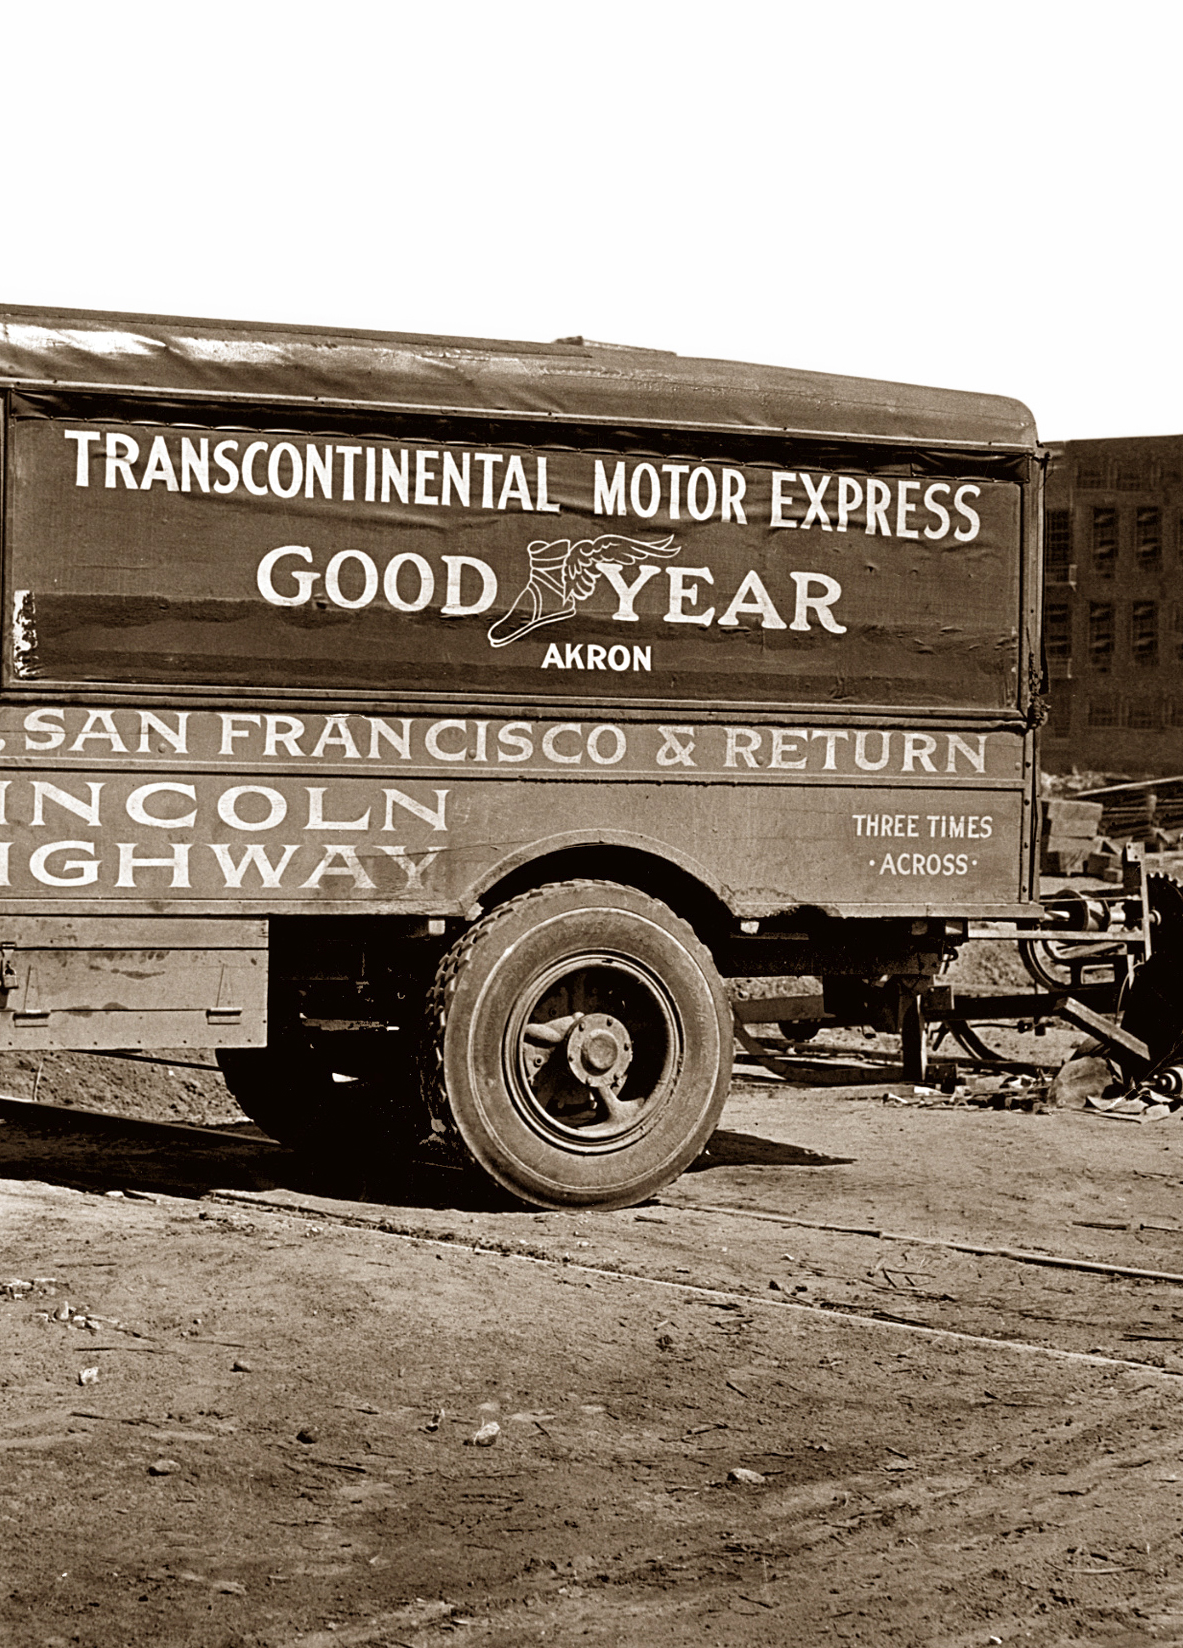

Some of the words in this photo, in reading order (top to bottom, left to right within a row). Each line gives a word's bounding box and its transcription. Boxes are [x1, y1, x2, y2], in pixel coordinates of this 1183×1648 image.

[64, 429, 561, 512] TRANSCONTINENTAL
[593, 460, 747, 525] MOTOR
[770, 471, 981, 542] EXPRESS
[257, 545, 499, 615] GOOD
[595, 563, 848, 634] YEAR
[541, 643, 652, 671] AKRON
[24, 709, 191, 754] SAN
[217, 713, 626, 765] FRANCISCO
[656, 725, 698, 767] &
[723, 727, 988, 774] RETURN
[852, 814, 919, 837] THREE
[926, 815, 993, 838] TIMES
